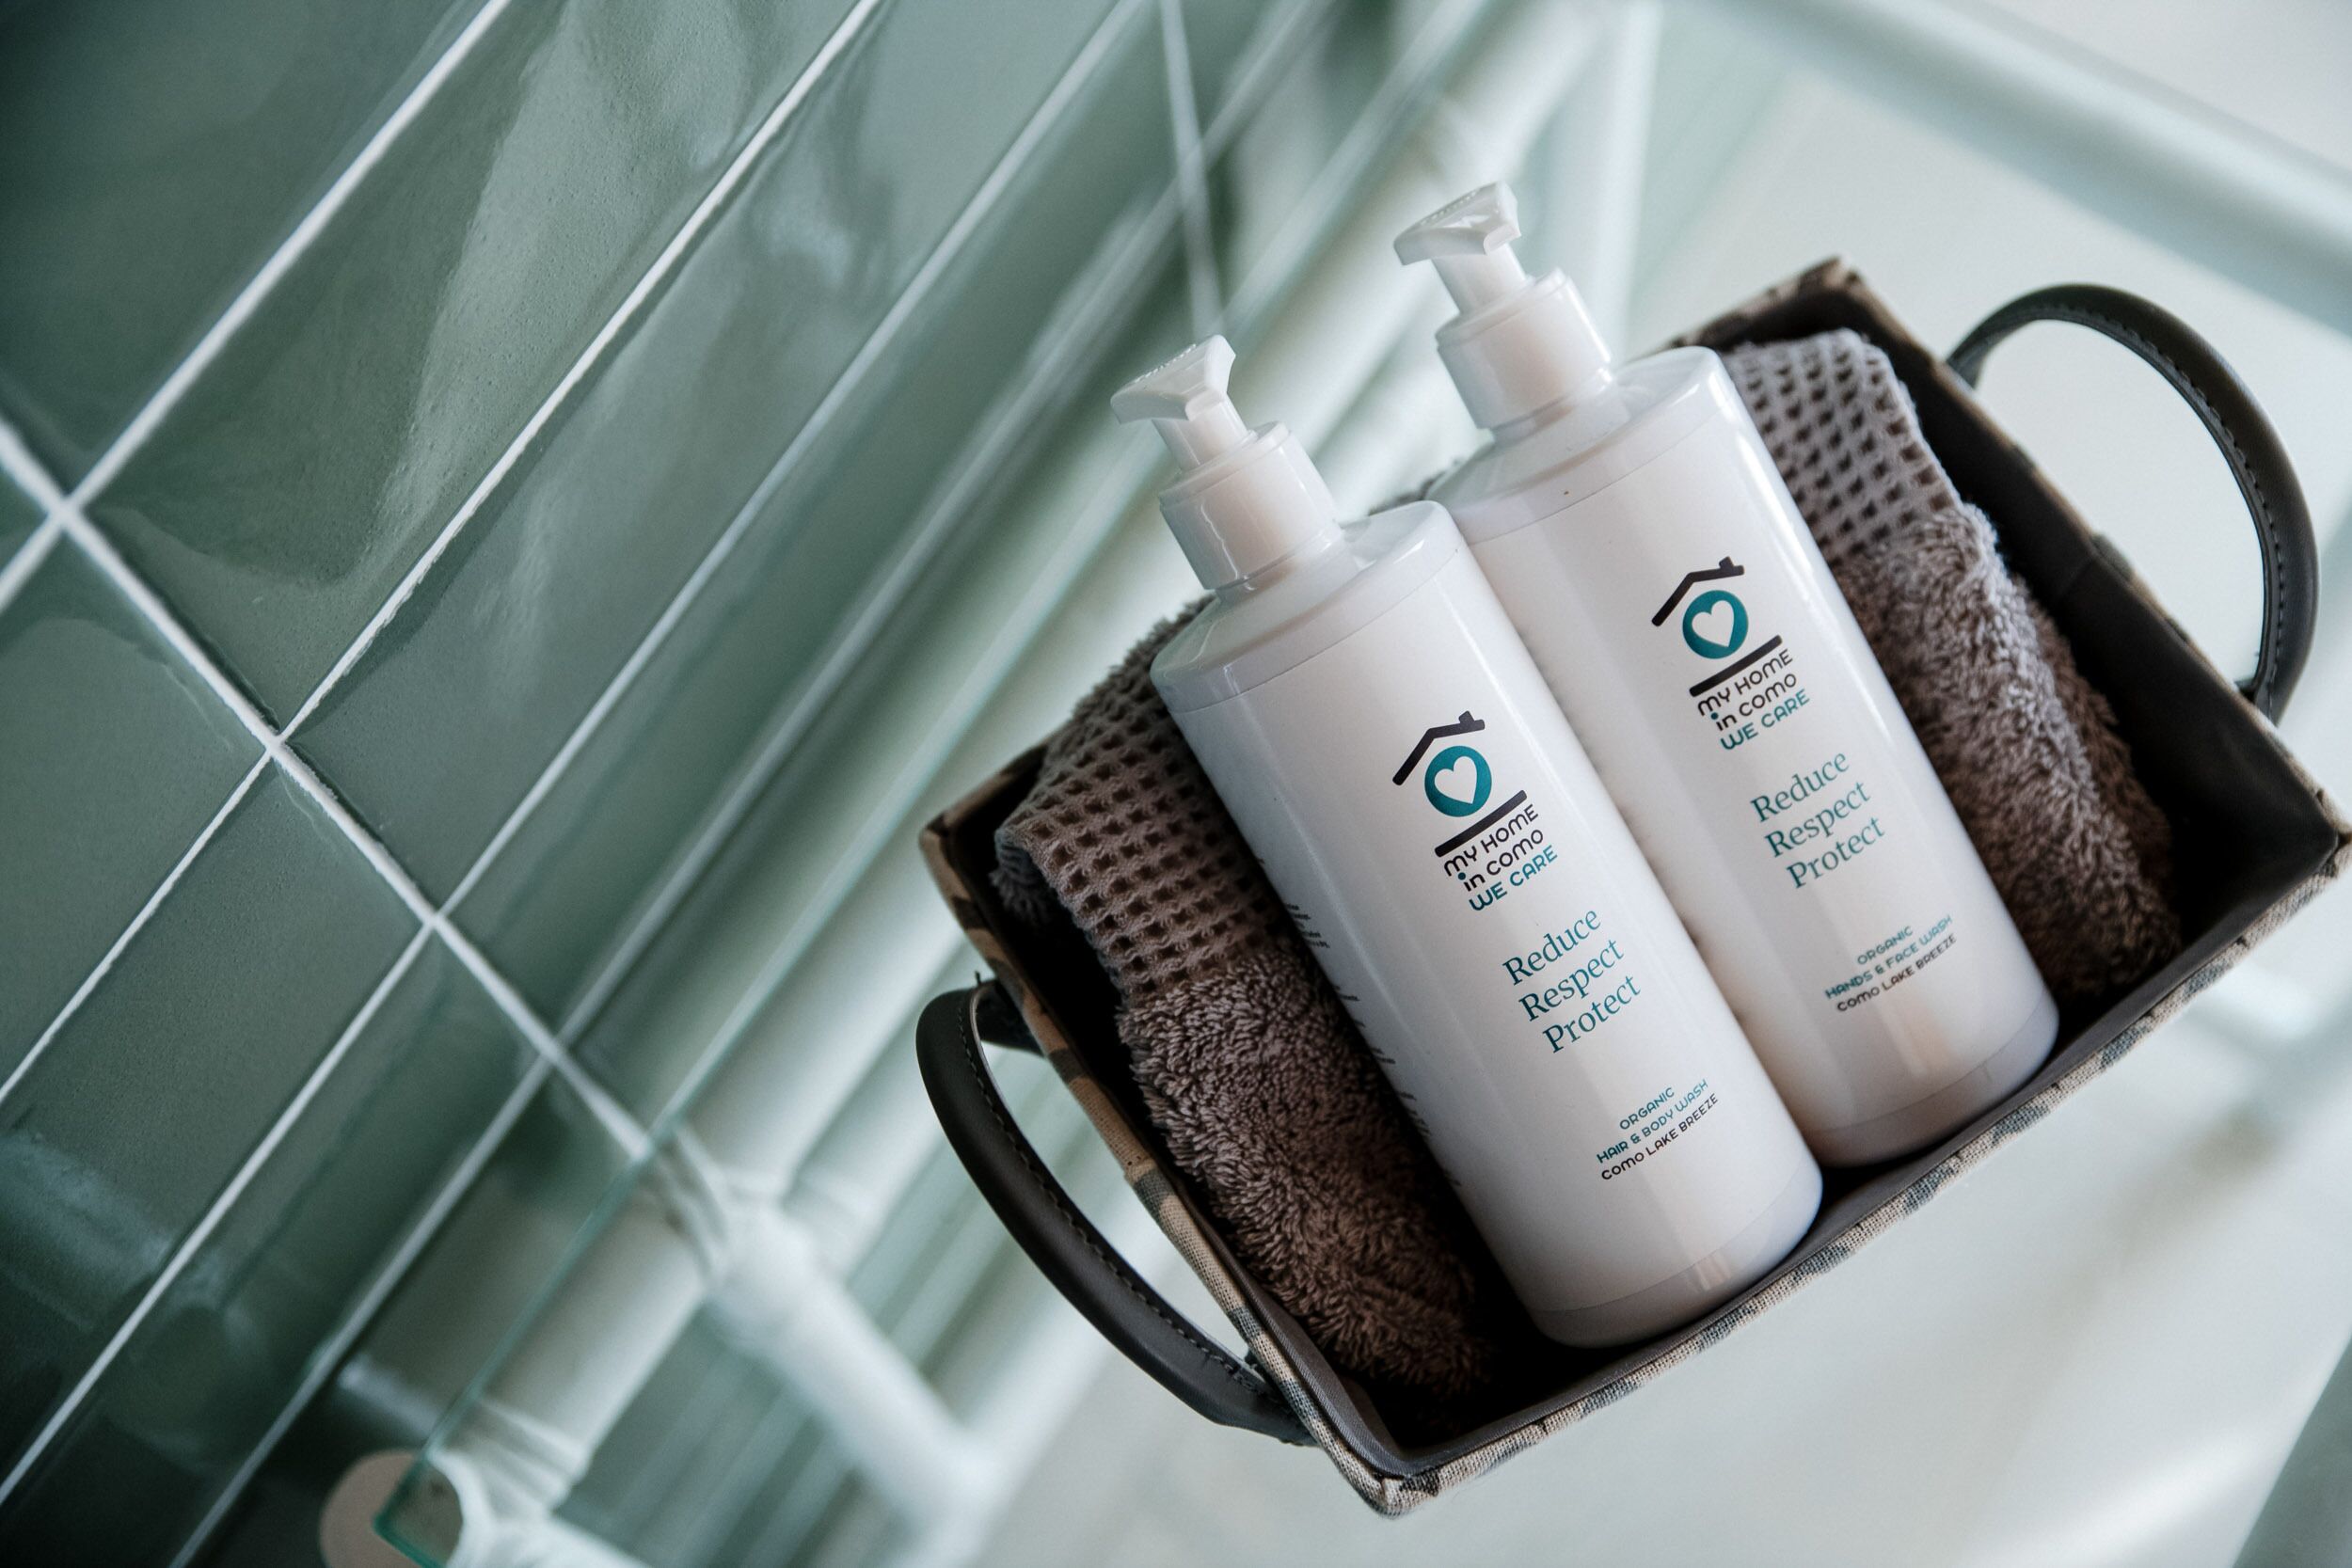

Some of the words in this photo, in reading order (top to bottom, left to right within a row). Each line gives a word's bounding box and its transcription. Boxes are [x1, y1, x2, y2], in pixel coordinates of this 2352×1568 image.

[1710, 712, 1738, 731] in
[1739, 673, 1797, 716] COMO
[1734, 648, 1793, 695] HOME
[1720, 722, 1758, 750] WE
[1761, 689, 1810, 728] CARE
[1750, 752, 1850, 823] Reduce
[1764, 782, 1871, 858] Respect
[1457, 872, 1486, 892] in
[1486, 829, 1544, 876] COMO
[1480, 803, 1539, 853] HOME
[1786, 816, 1885, 889] Protect
[1469, 881, 1508, 911] WE
[1509, 845, 1558, 887] CARE
[1502, 911, 1601, 986] Reduce
[1518, 939, 1625, 1022] Respect
[1824, 971, 1873, 1000] HANDS
[1874, 964, 1885, 974] &
[1885, 942, 1919, 969] FACE
[1918, 913, 1953, 945] WASH
[1836, 986, 1880, 1012] COMO
[1881, 965, 1915, 990] LAKE
[1915, 932, 1957, 970] BREEZE
[1857, 926, 1914, 965] ORGANIC
[1542, 975, 1641, 1053] Protect
[1596, 1141, 1629, 1164] HAIR
[1629, 1132, 1642, 1144] &
[1641, 1109, 1674, 1137] BODY
[1675, 1079, 1708, 1112] WASH
[1601, 1152, 1645, 1180] COMO
[1645, 1128, 1678, 1156] LAKE
[1678, 1093, 1719, 1132] BREEZE
[1619, 1086, 1675, 1130] ORGANIC
